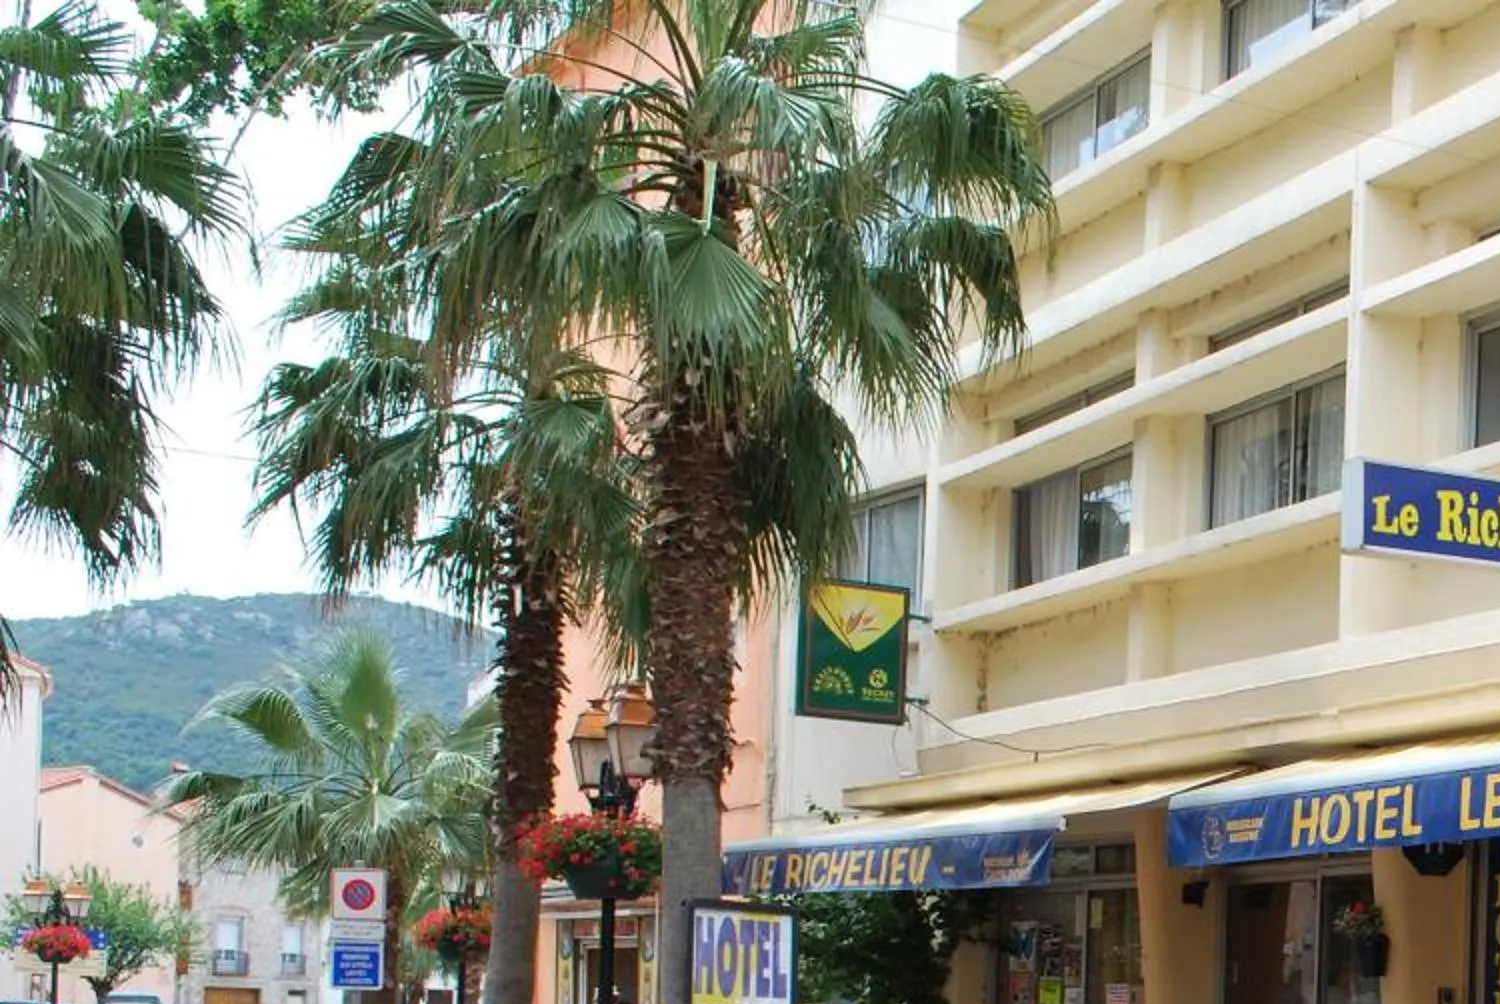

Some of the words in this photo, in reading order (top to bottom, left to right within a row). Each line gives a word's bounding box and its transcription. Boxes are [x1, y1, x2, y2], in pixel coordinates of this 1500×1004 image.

[1372, 495, 1419, 537] Le
[1291, 784, 1422, 848] HOTEL
[750, 855, 777, 890] LE
[785, 845, 932, 889] RICHELIEU
[694, 915, 787, 998] HOTEL
